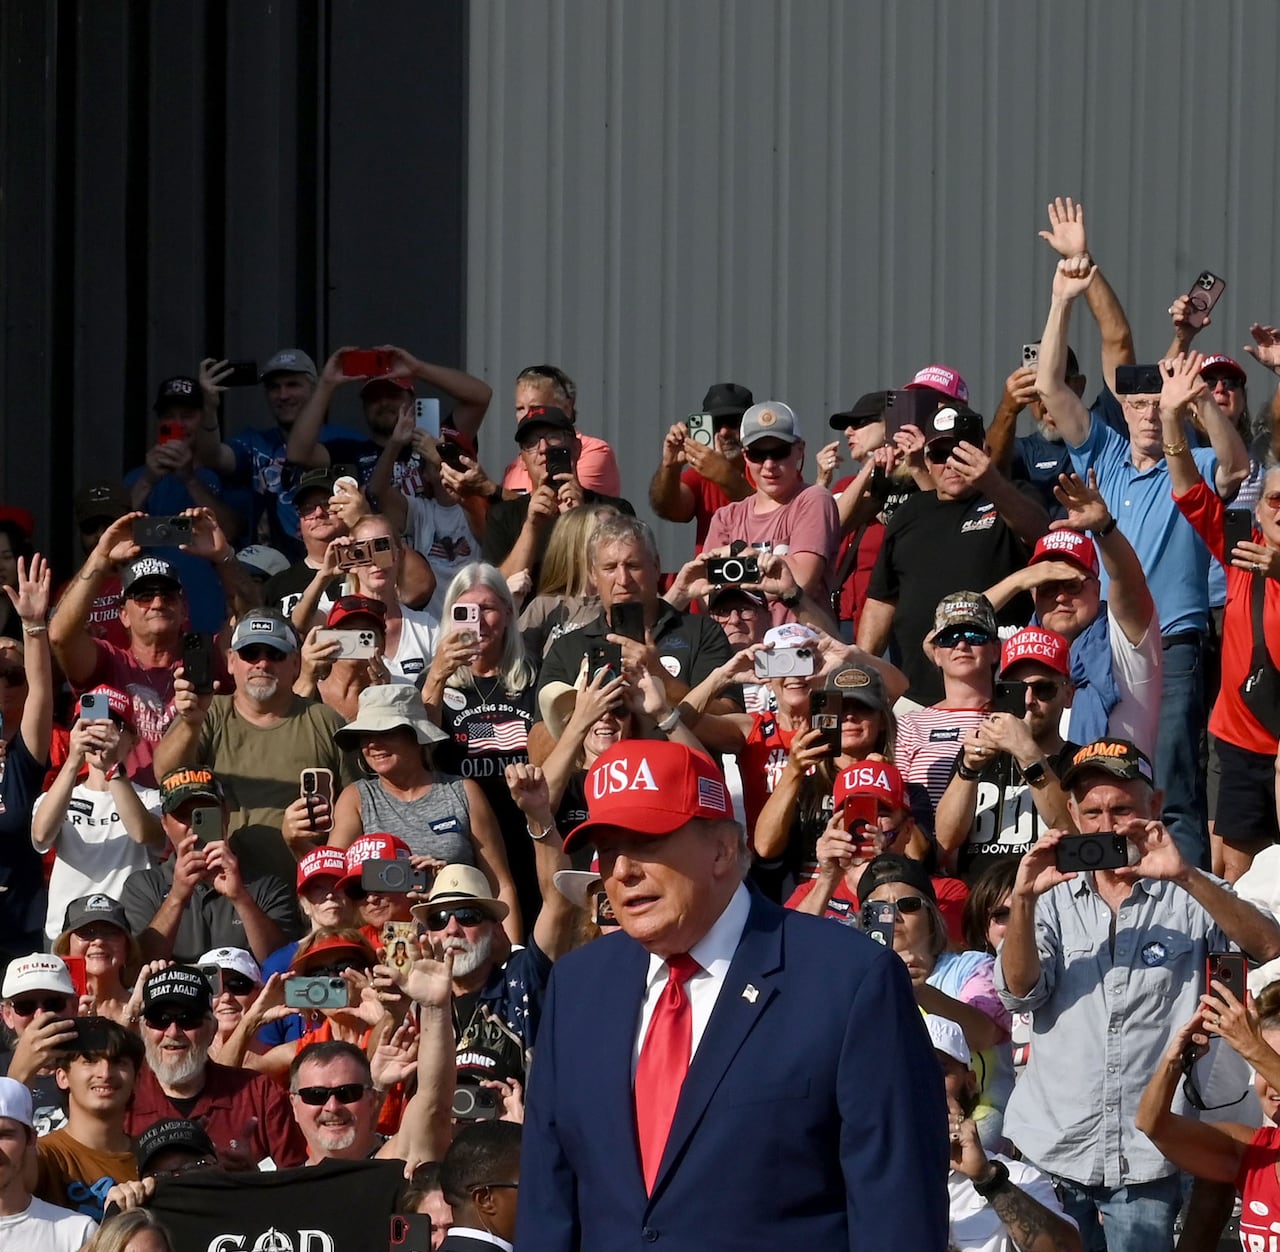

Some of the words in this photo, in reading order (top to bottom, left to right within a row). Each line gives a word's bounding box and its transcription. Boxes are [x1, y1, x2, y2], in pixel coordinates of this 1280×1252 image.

[1006, 631, 1060, 652] AMERICA
[1017, 644, 1057, 659] BACK!
[499, 703, 513, 713] 250
[1073, 742, 1128, 766] TRUMP
[461, 758, 494, 778] OLD
[162, 769, 212, 791] TRUMP
[592, 756, 660, 800] USA
[843, 767, 892, 792] USA
[981, 843, 1008, 854] DON
[323, 857, 344, 869] AGAIN
[148, 972, 167, 987] MAKE
[167, 971, 201, 986] AMERICA
[173, 983, 199, 998] AGAIN
[456, 1053, 496, 1067] RUMP
[160, 1120, 195, 1132] AMERICA
